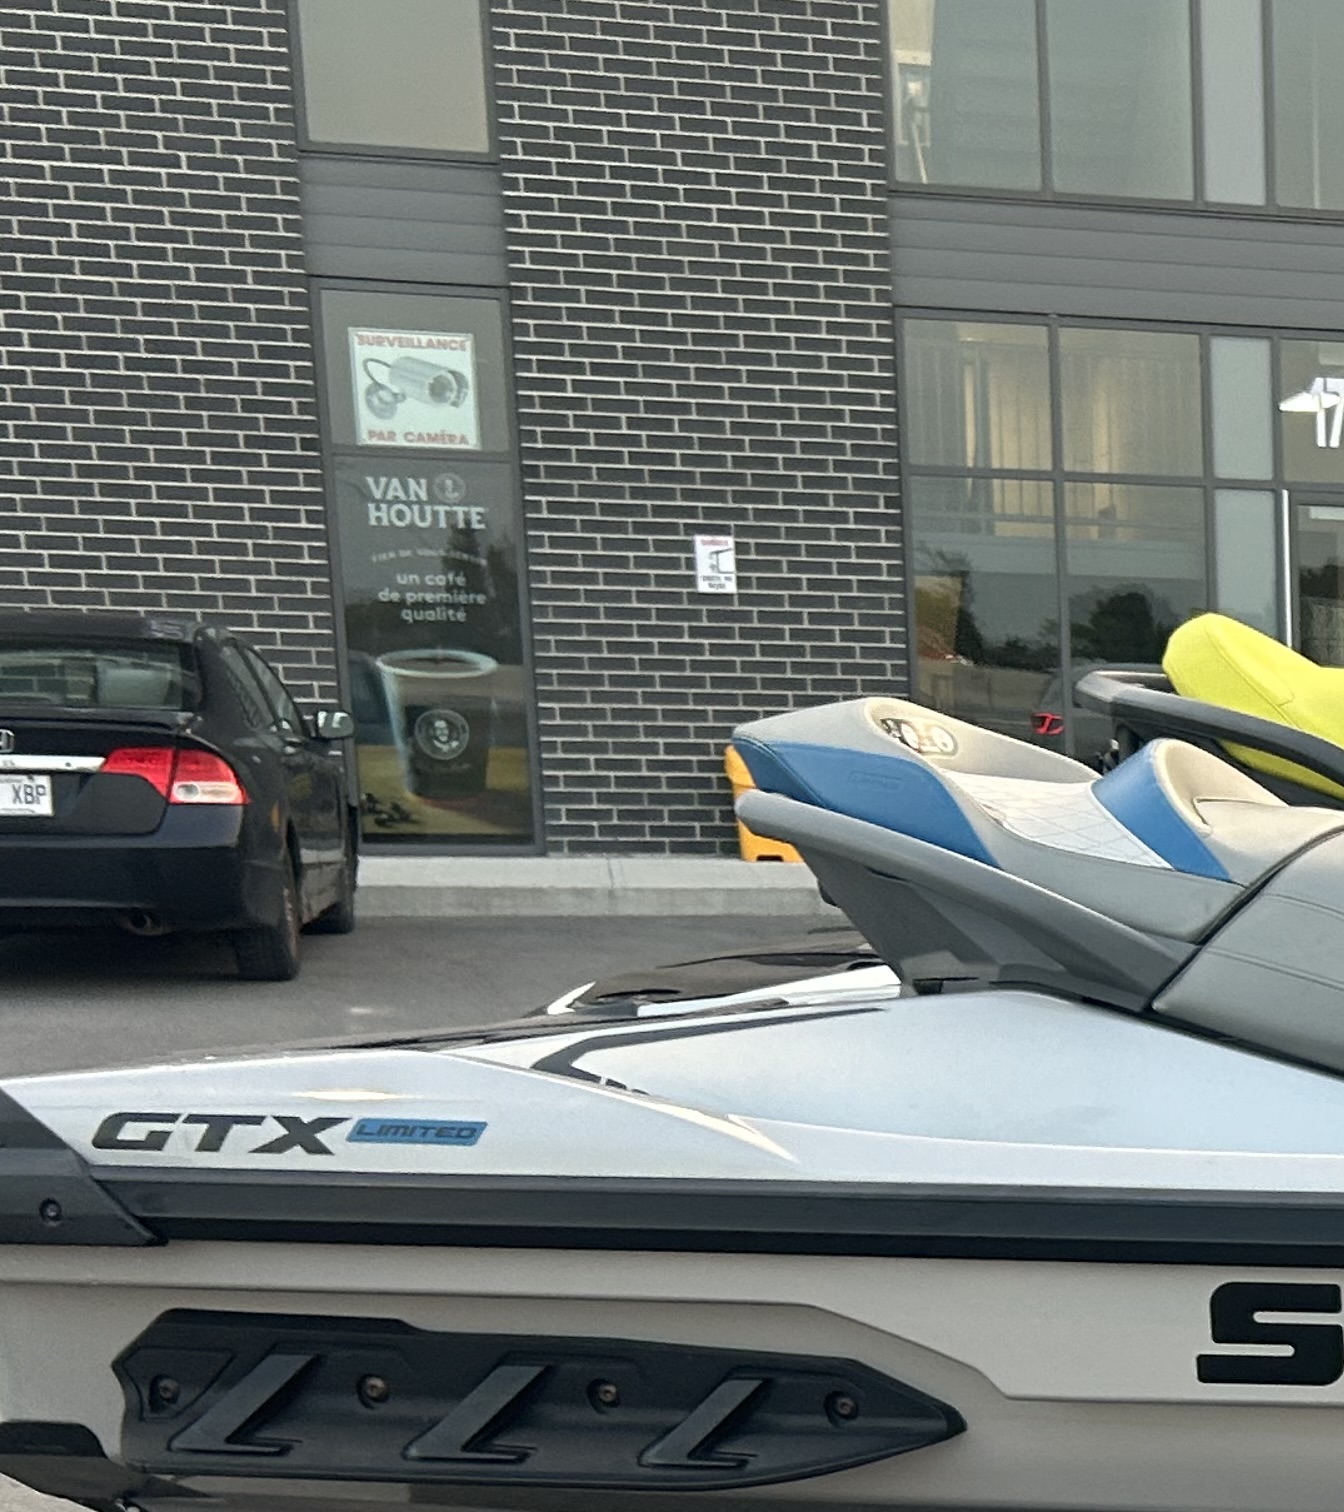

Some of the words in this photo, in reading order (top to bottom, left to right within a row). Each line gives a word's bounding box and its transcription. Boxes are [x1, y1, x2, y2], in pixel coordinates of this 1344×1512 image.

[356, 334, 467, 351] SURVEILLANCE
[367, 429, 396, 442] PAR
[365, 476, 428, 501] VAN
[368, 503, 487, 529] HOUTTE
[396, 573, 420, 585] un
[425, 571, 466, 586] café
[378, 587, 400, 602] de
[405, 589, 487, 605] première
[402, 606, 467, 624] qualité
[91, 1111, 353, 1156] GTX
[356, 1122, 478, 1140] LIMITED
